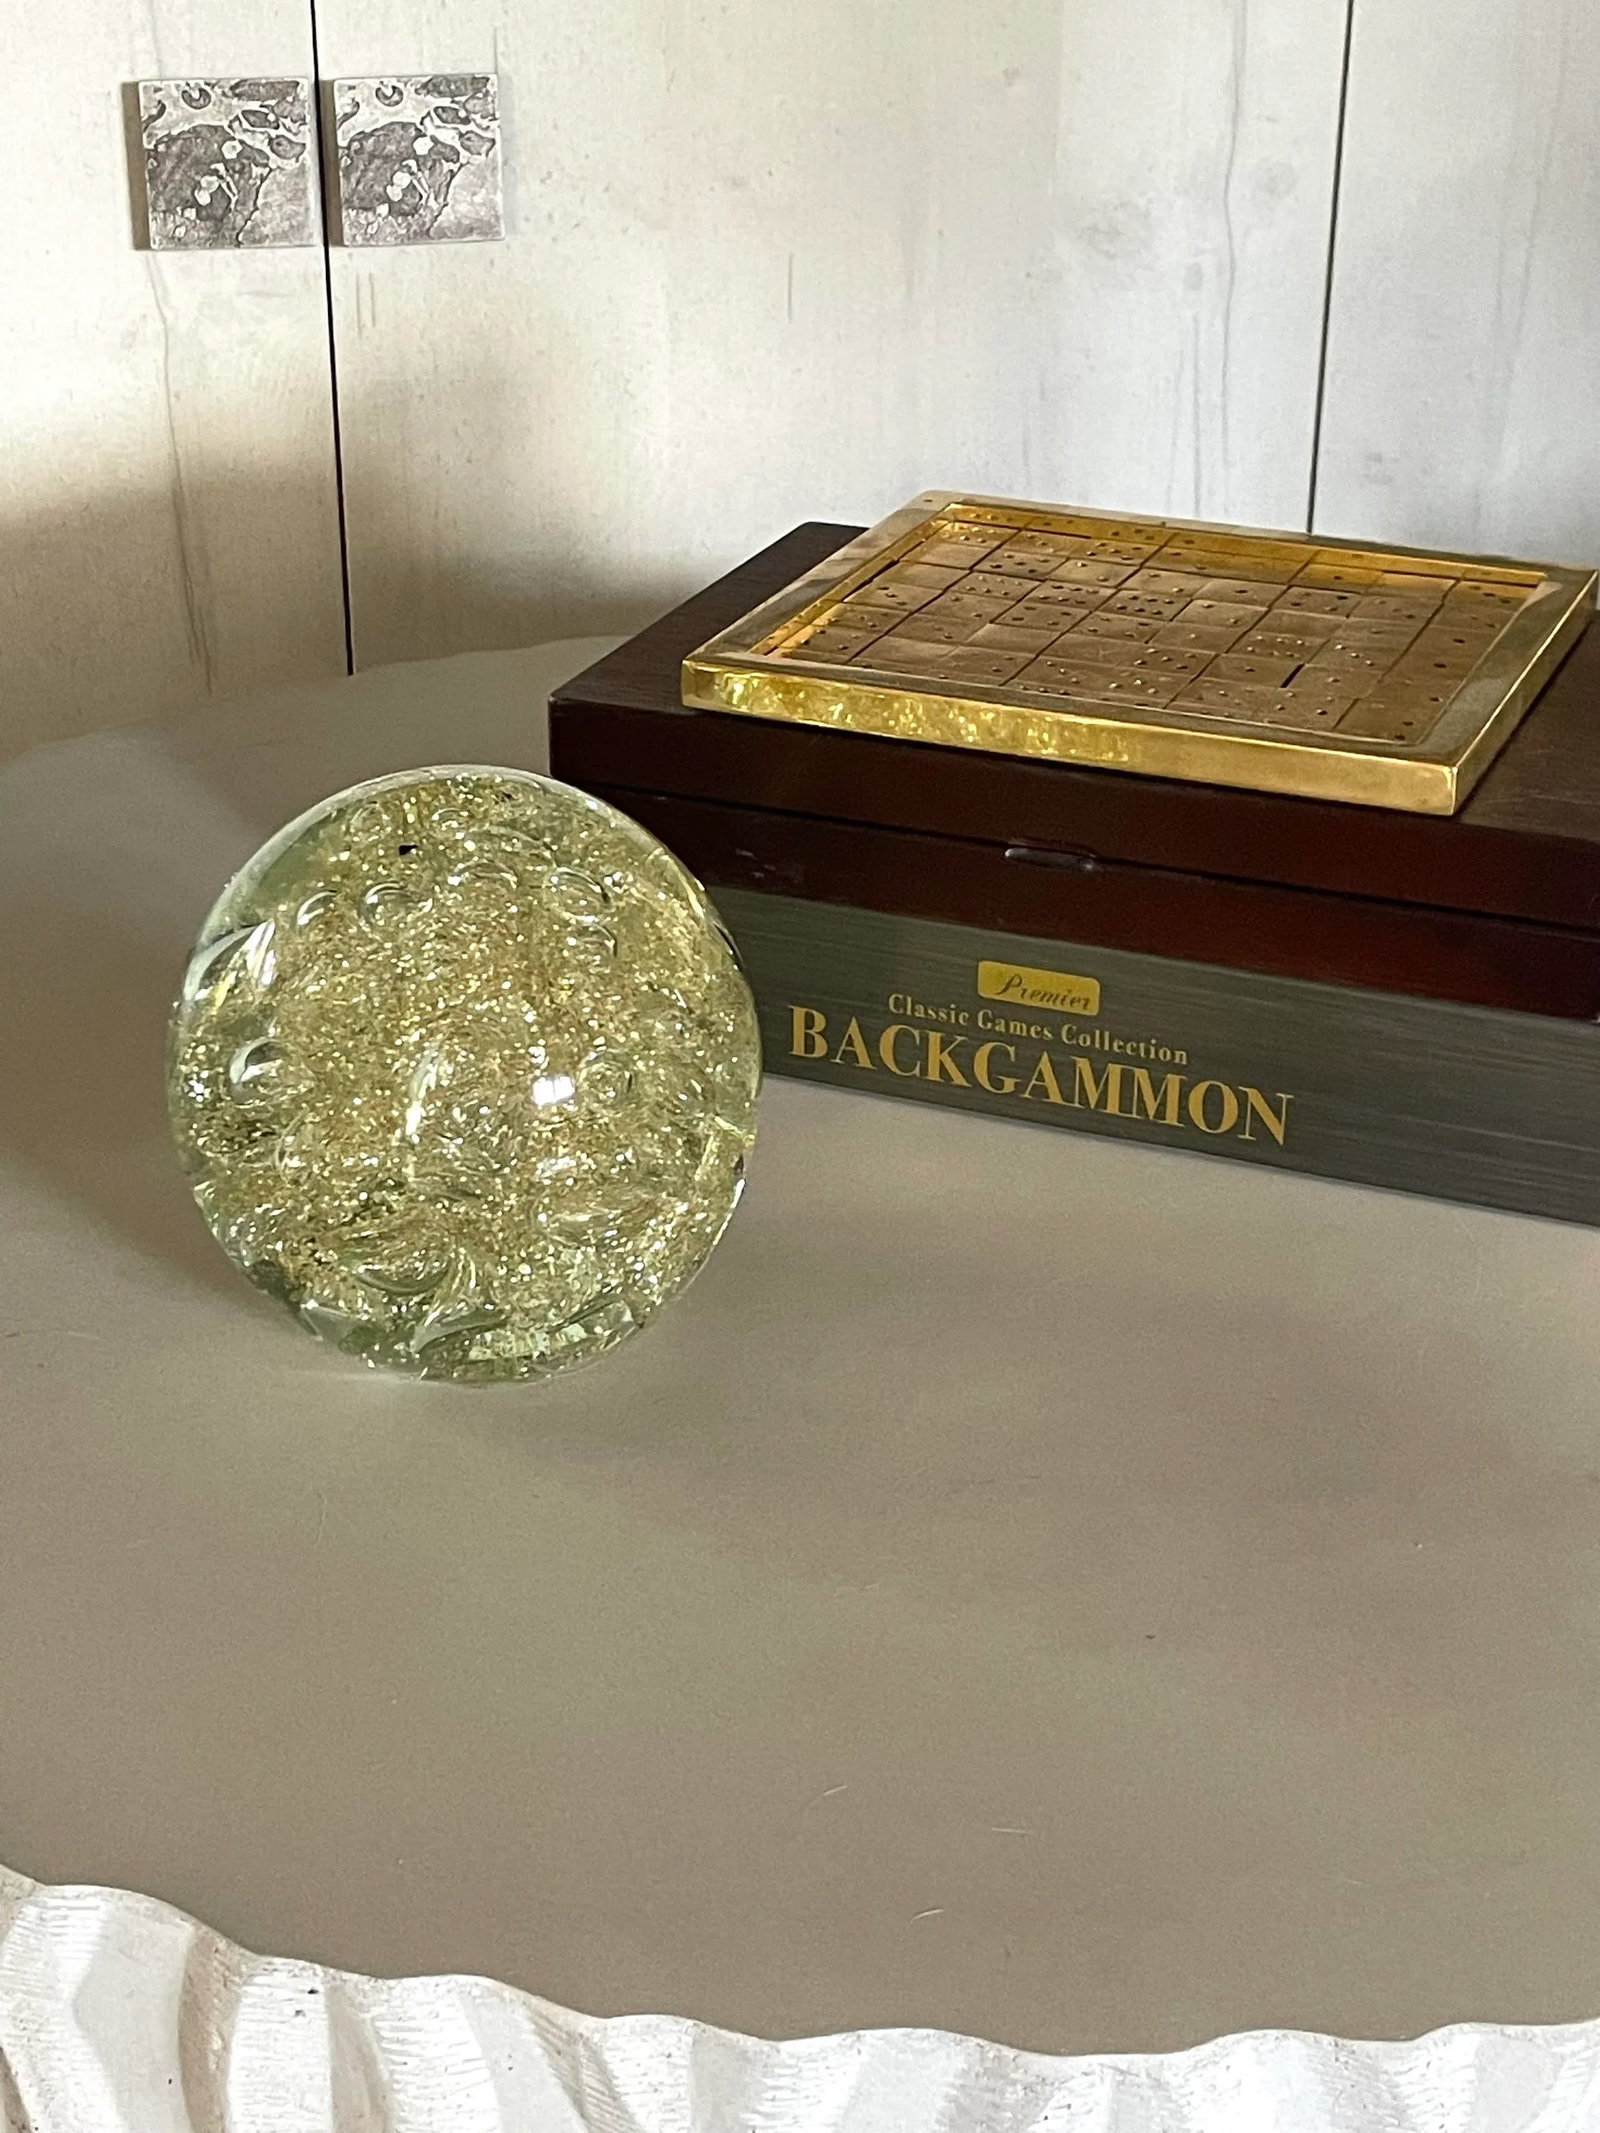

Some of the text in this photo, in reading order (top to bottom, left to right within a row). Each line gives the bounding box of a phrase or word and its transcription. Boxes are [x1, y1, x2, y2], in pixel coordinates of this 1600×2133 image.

[995, 973, 1091, 1011] Premier
[887, 993, 1189, 1066] Classic Games Collection
[788, 1005, 1295, 1147] BACKGAMMON
